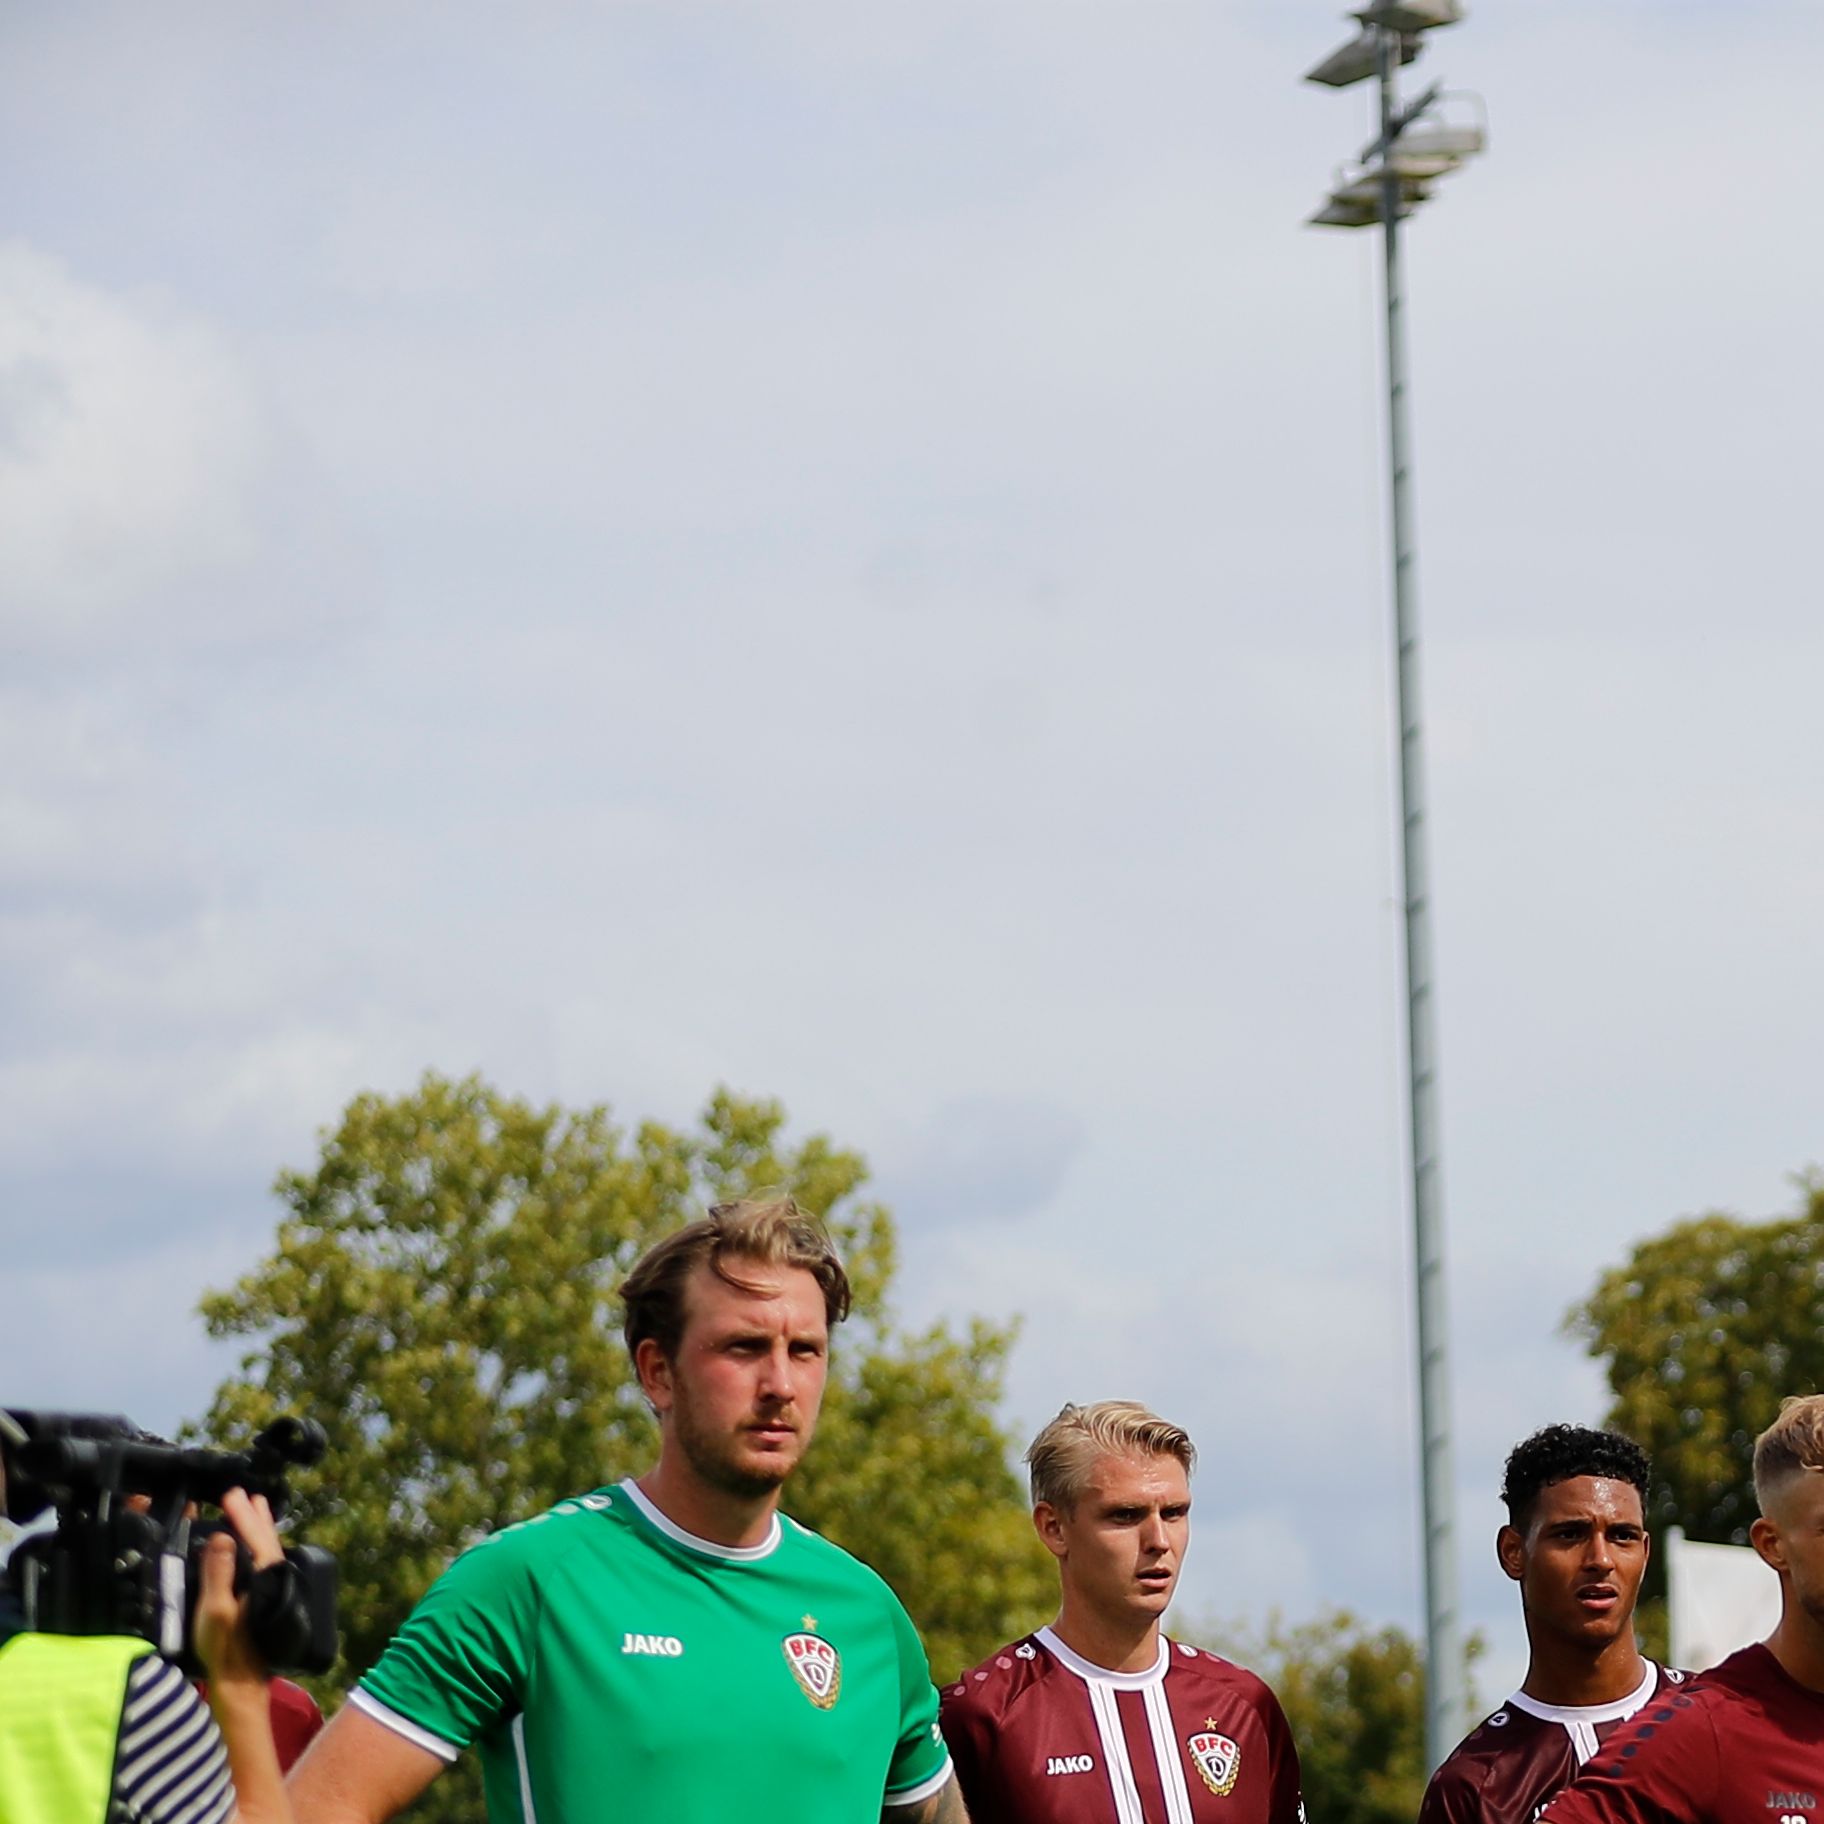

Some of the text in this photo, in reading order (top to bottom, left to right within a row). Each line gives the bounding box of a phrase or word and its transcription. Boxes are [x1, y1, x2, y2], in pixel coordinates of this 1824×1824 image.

[622, 1632, 684, 1658] JAKO
[788, 1638, 832, 1669] BFC
[1194, 1737, 1235, 1758] BFC
[1046, 1754, 1094, 1776] JAKO
